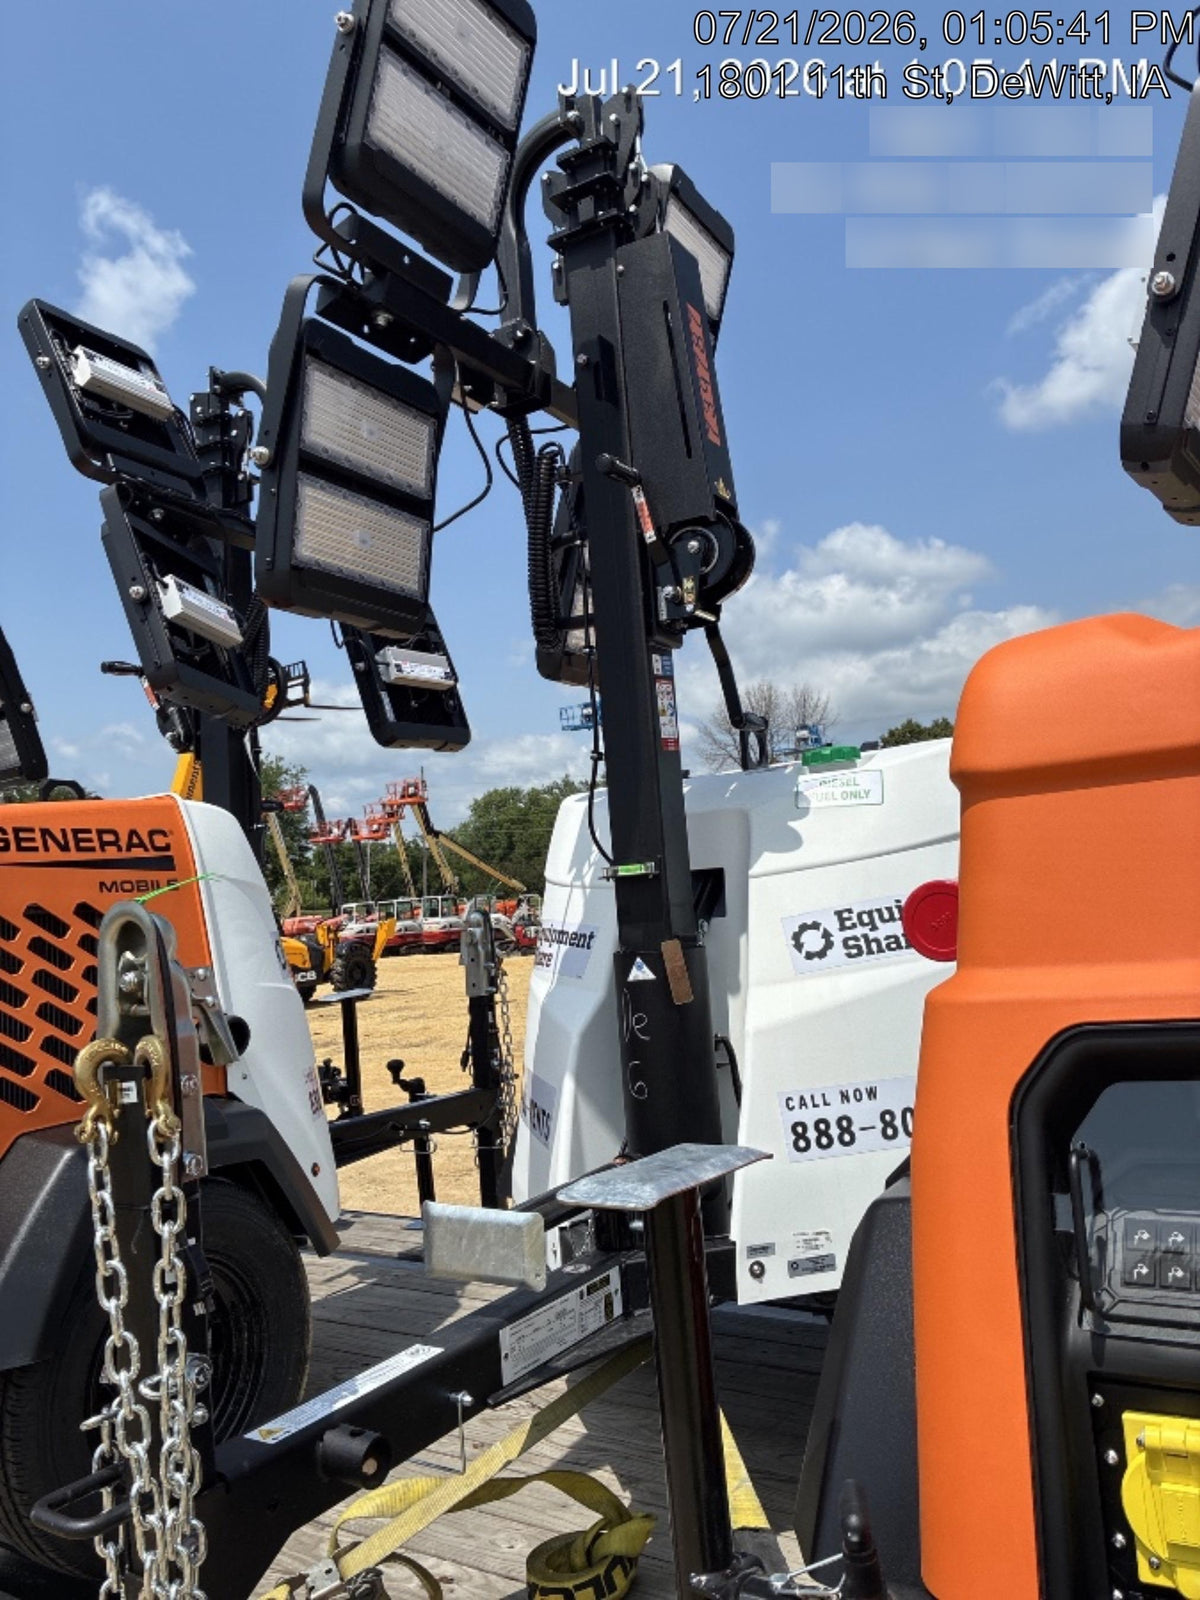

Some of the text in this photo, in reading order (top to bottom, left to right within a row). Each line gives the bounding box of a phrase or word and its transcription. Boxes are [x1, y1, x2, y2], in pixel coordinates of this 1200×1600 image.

[810, 788, 873, 802] UEL ONLY
[295, 970, 317, 982] CB
[785, 1085, 878, 1111] CALL NOW
